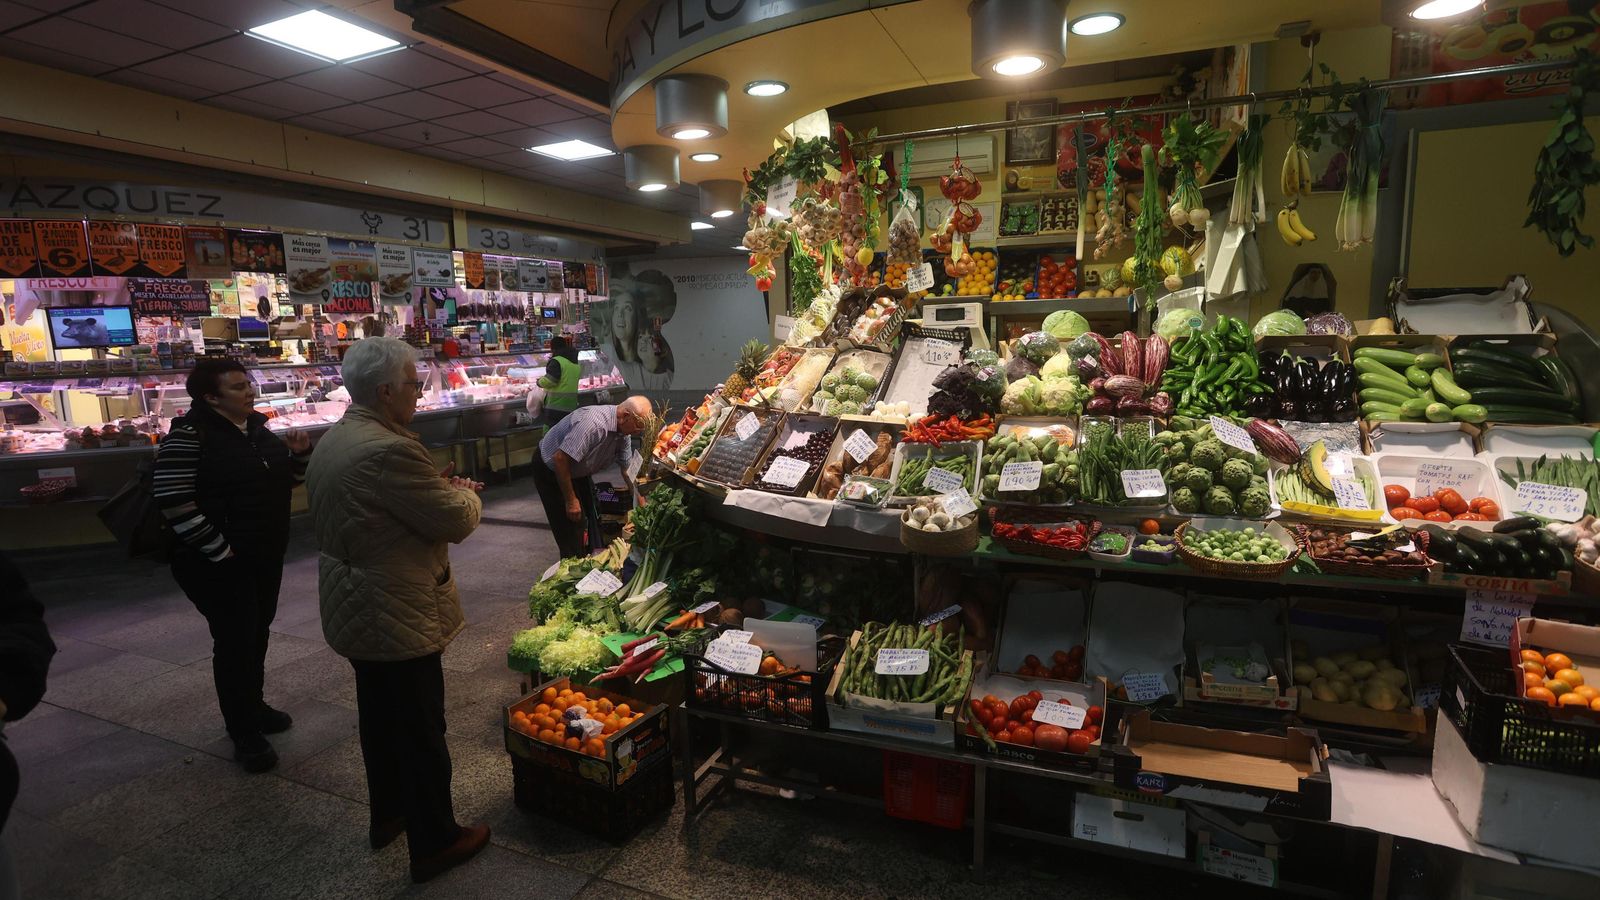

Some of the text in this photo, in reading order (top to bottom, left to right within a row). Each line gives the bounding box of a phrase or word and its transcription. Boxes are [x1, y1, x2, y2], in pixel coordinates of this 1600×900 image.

[138, 225, 180, 239] LECHAZO
[403, 216, 430, 243] 31
[3, 236, 20, 246] DE
[140, 239, 183, 251] FRESCO
[292, 237, 304, 246] Más
[480, 228, 510, 250] 33
[301, 247, 321, 256] mejor
[29, 279, 87, 288] FRESCO
[144, 283, 192, 294] FRESCO
[327, 280, 369, 299] RESCO
[136, 299, 174, 311] TIERRA
[323, 298, 372, 312] NACIONAL
[1136, 775, 1164, 788] KANZI
